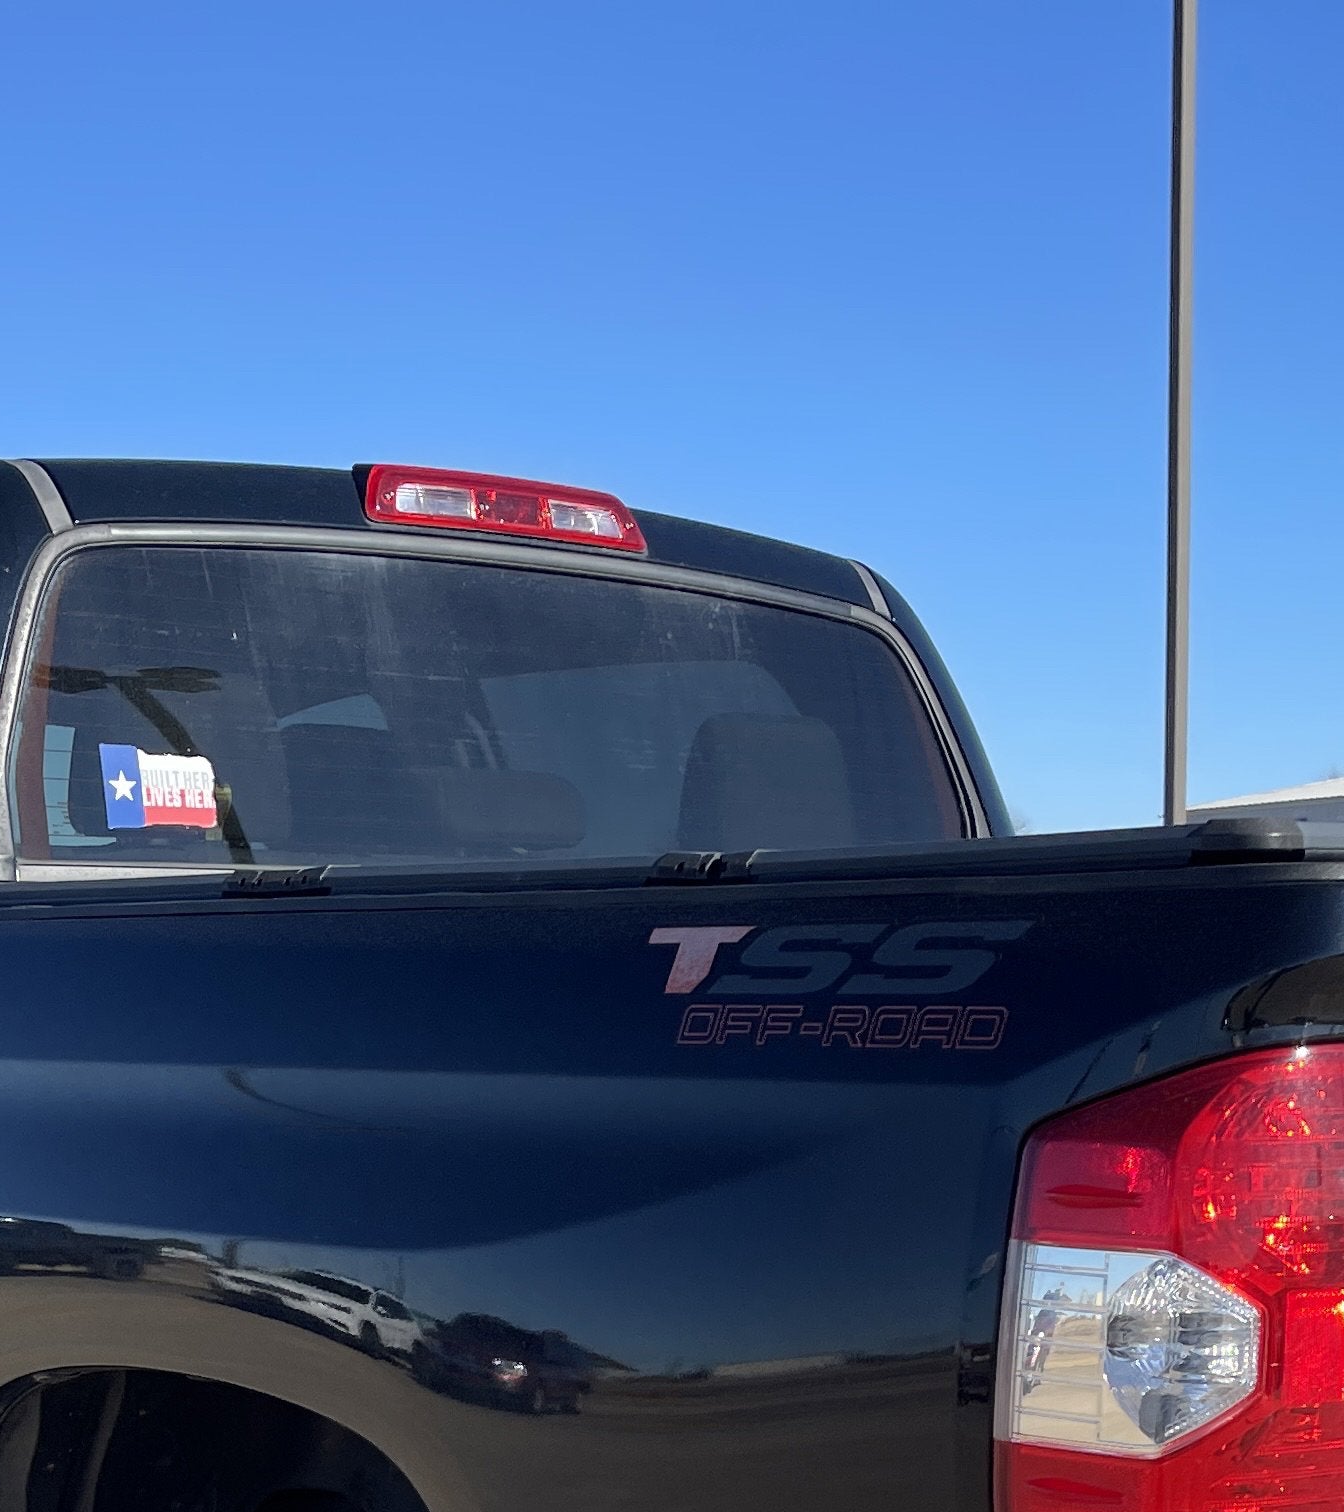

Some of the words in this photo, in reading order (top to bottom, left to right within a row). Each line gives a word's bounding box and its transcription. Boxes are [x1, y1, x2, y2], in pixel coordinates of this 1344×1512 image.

[141, 769, 180, 788] BUILT
[182, 771, 213, 790] HER
[143, 786, 184, 808] LIVES
[648, 920, 1036, 995] TSS
[676, 1003, 1009, 1051] OFF-ROAD
